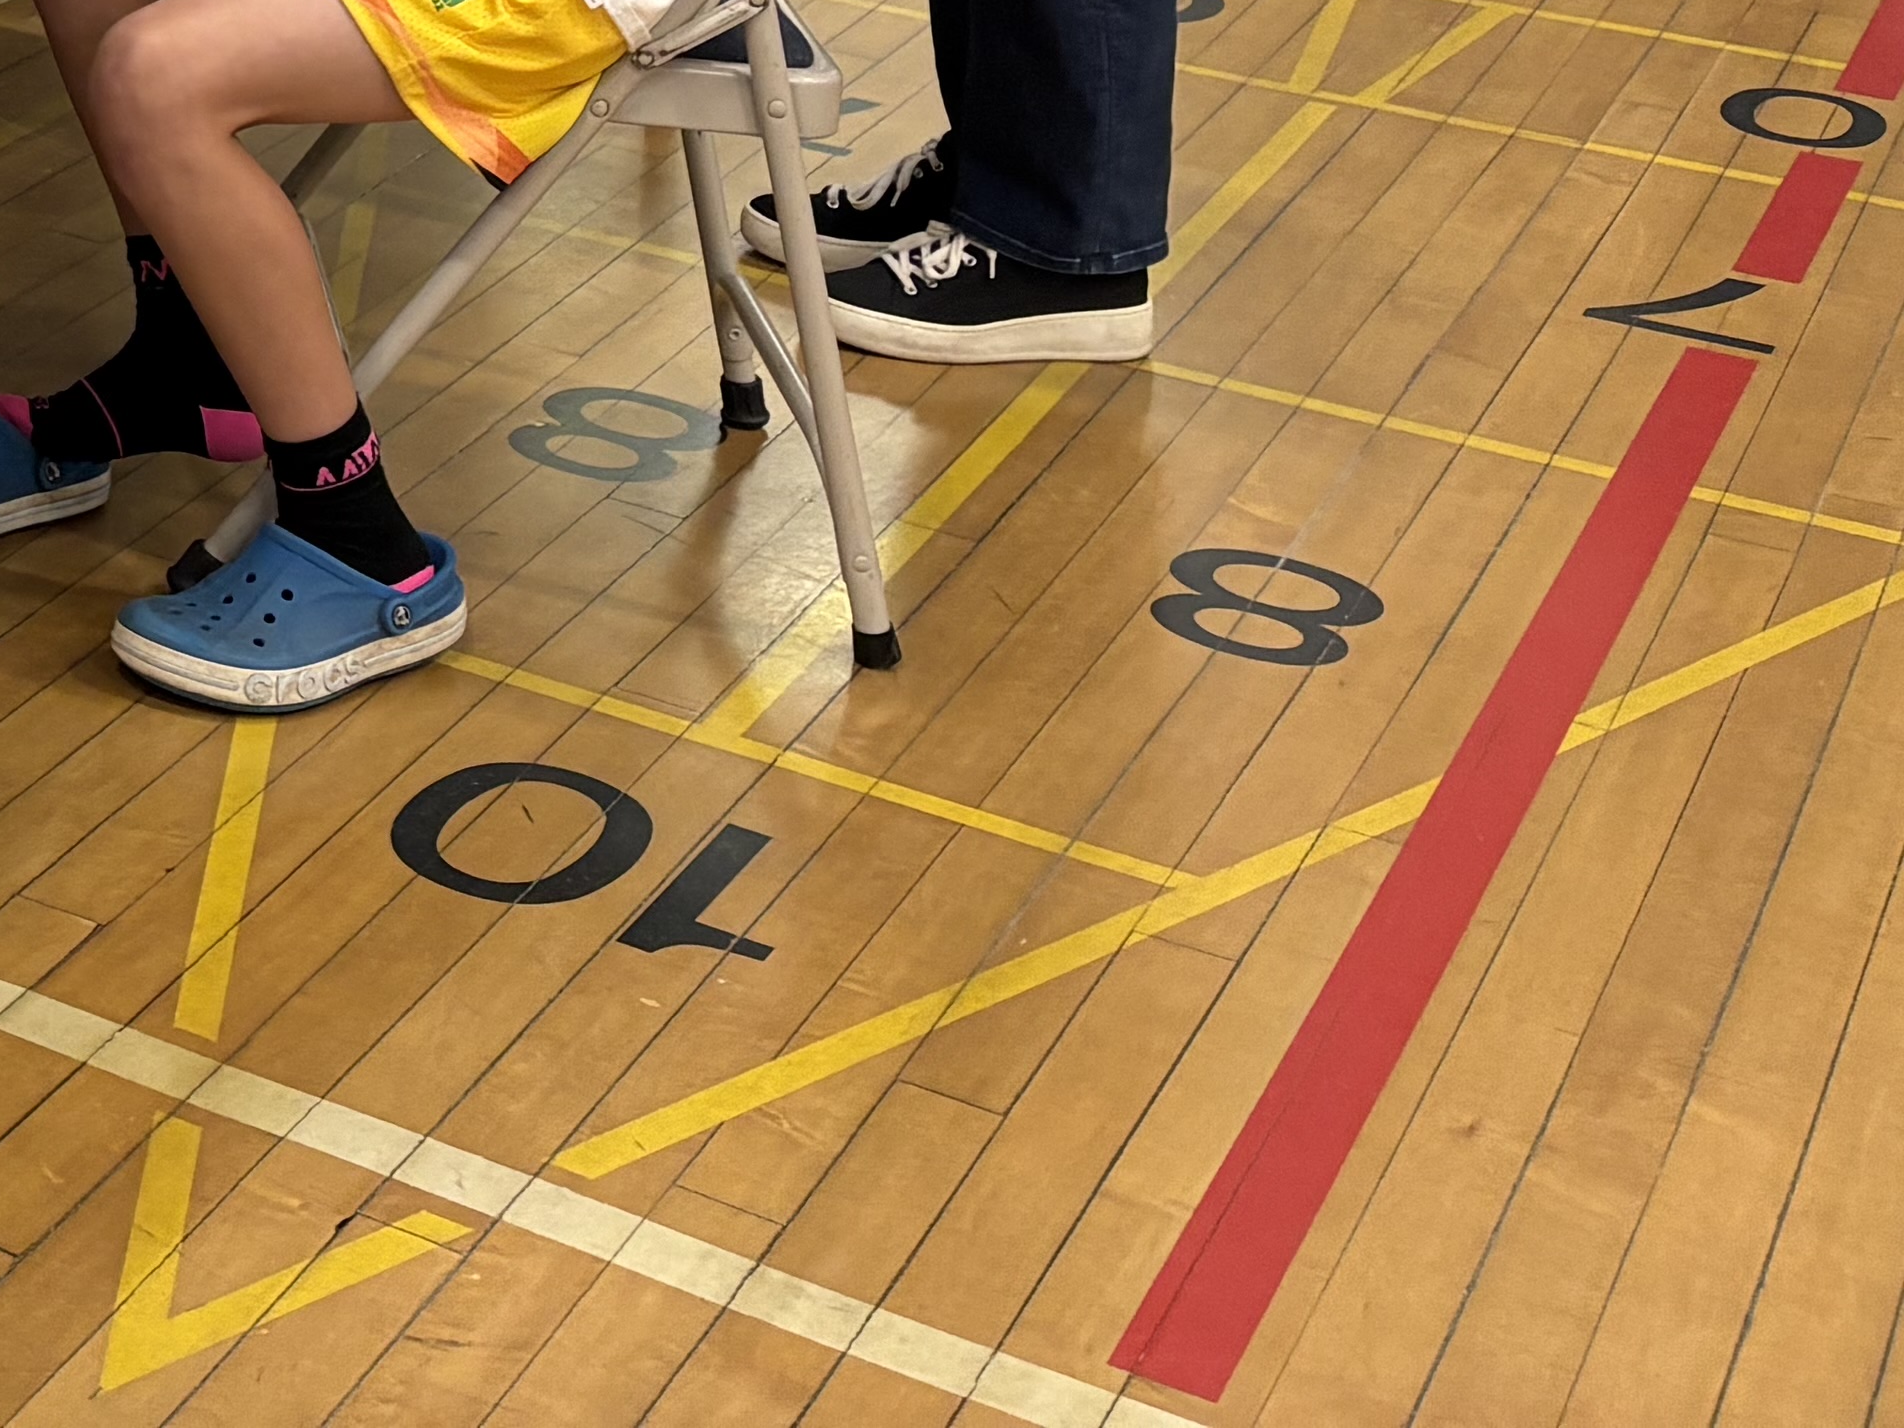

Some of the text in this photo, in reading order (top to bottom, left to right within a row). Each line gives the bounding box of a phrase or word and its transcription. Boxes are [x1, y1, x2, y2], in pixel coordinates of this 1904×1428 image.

[1583, 278, 1776, 355] 7
[1151, 547, 1385, 669] 8
[390, 761, 773, 962] 10
